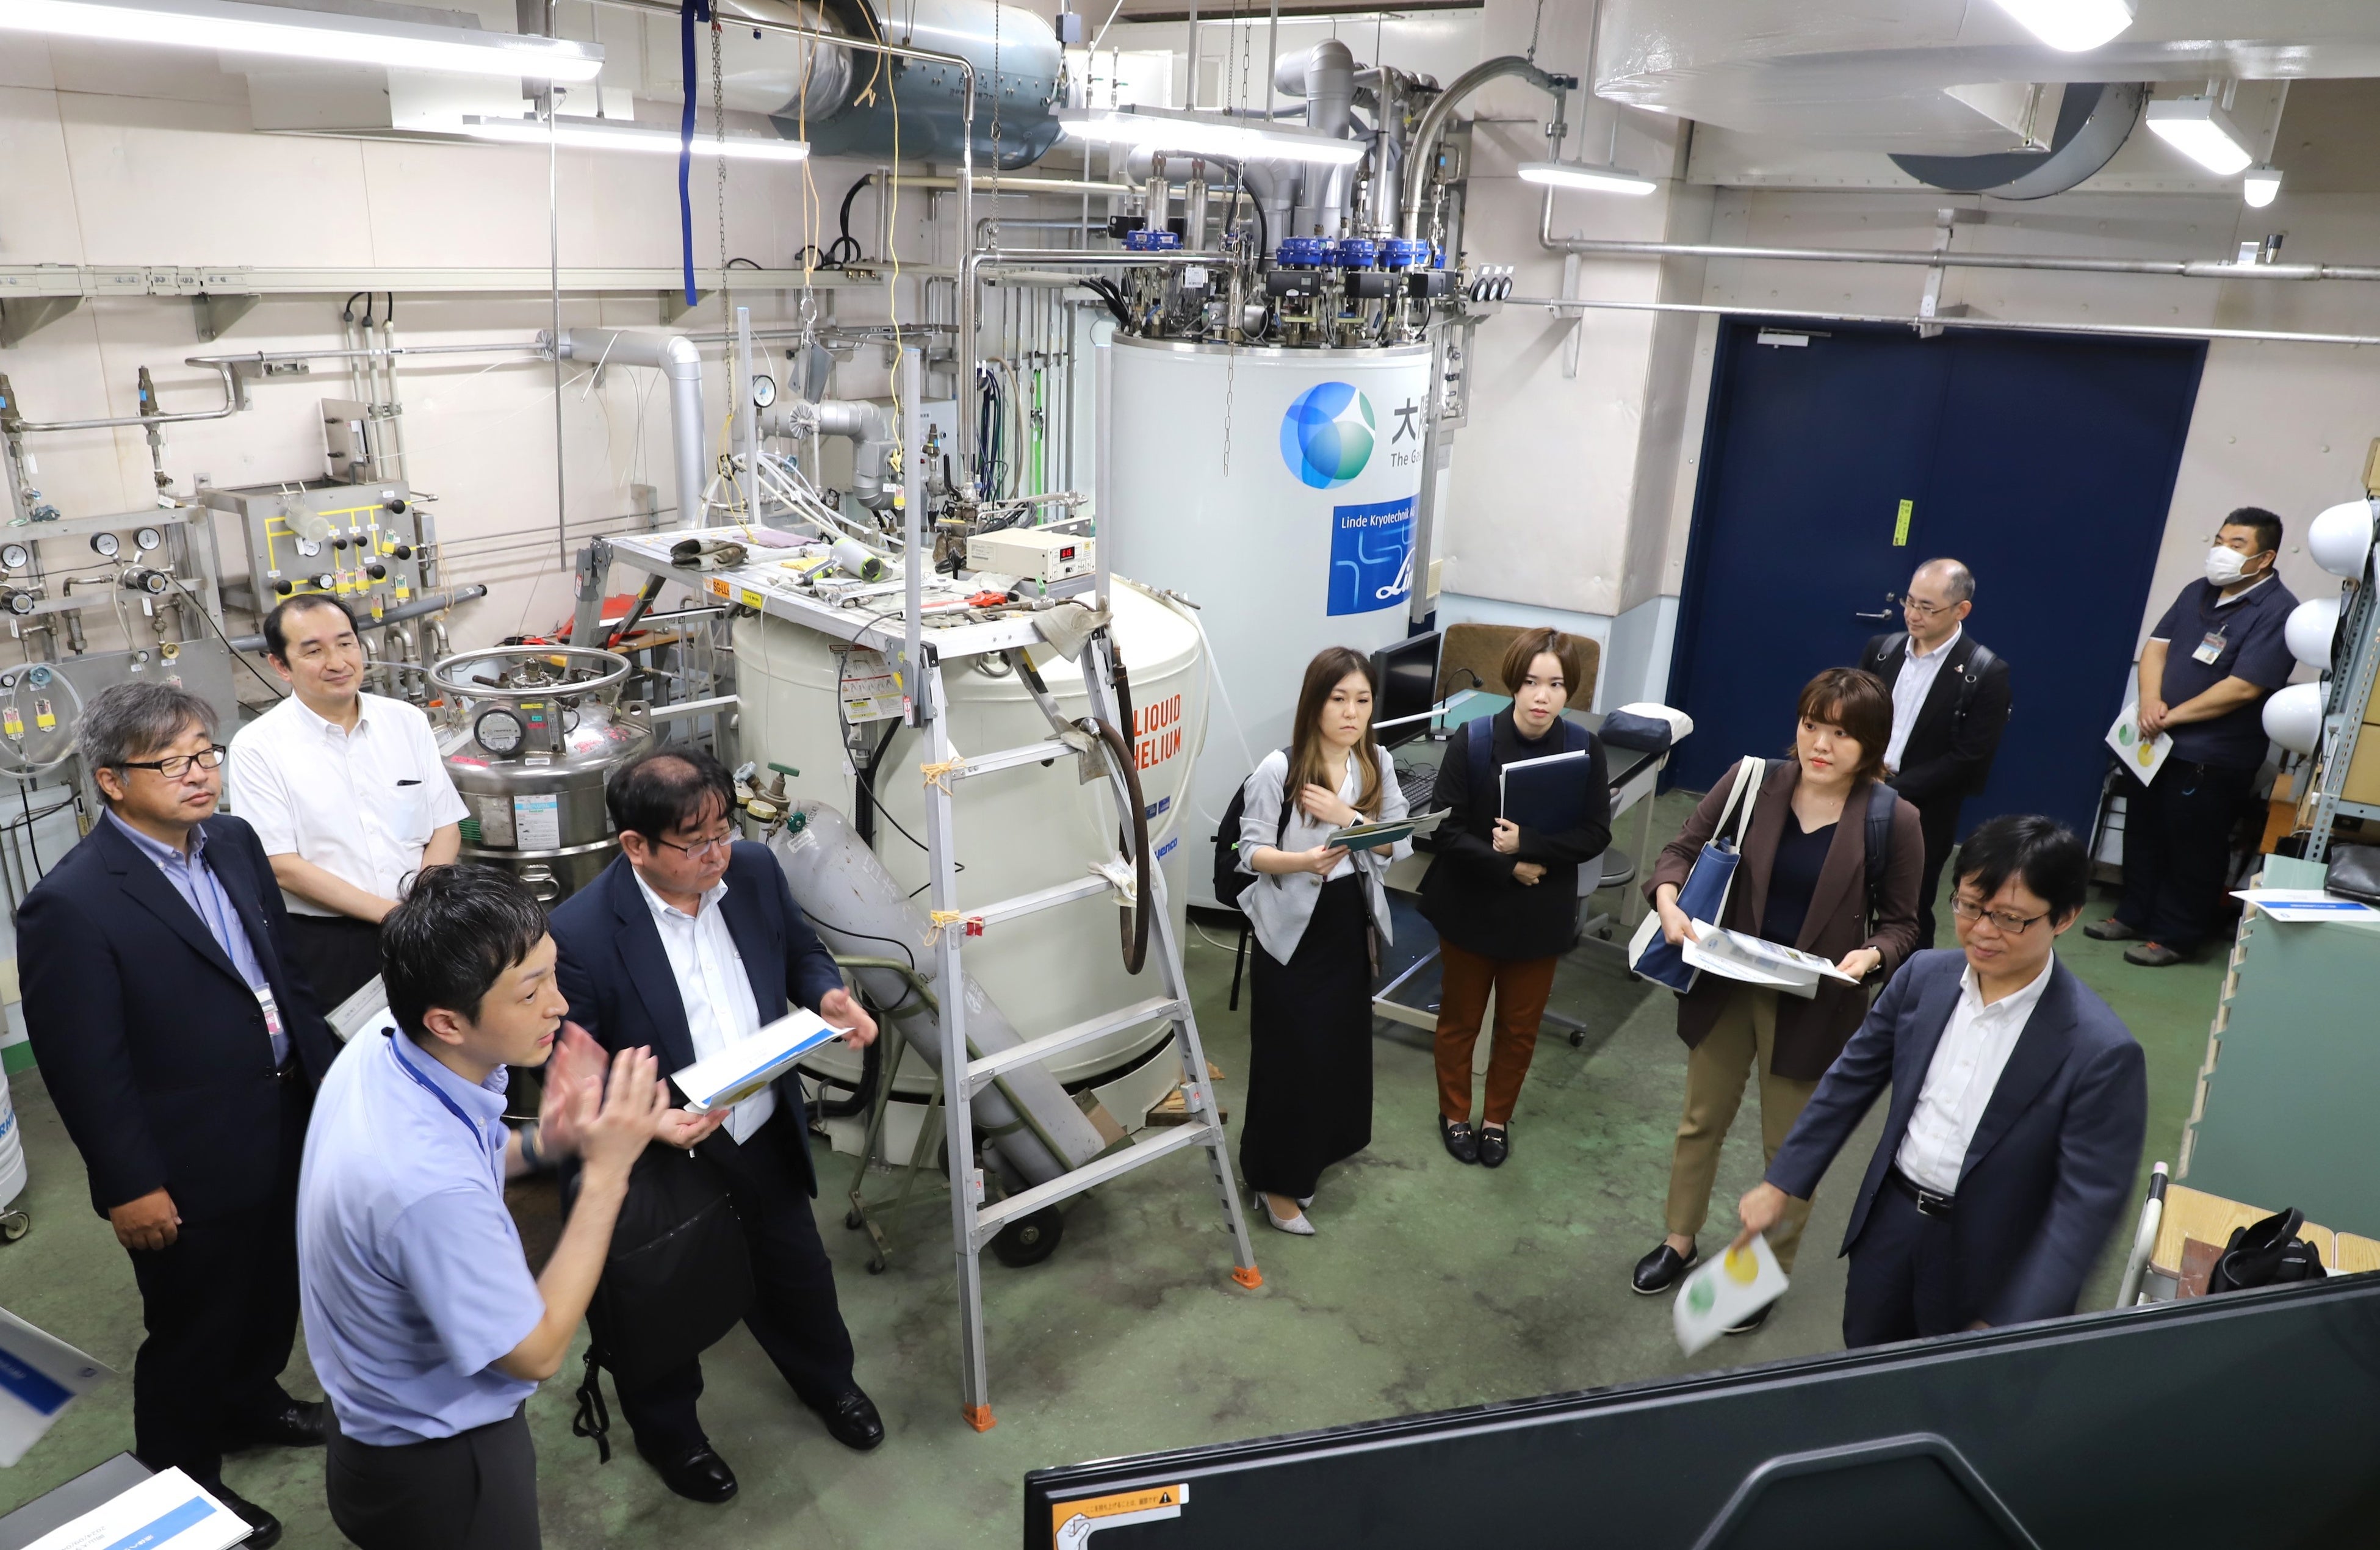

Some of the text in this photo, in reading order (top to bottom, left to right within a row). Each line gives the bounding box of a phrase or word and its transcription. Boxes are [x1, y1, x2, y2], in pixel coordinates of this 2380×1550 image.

[1391, 452, 1408, 467] The
[1411, 449, 1422, 464] Gas
[1341, 506, 1416, 528] Linde Kryotechnik AG
[1133, 694, 1181, 737] LIQUID
